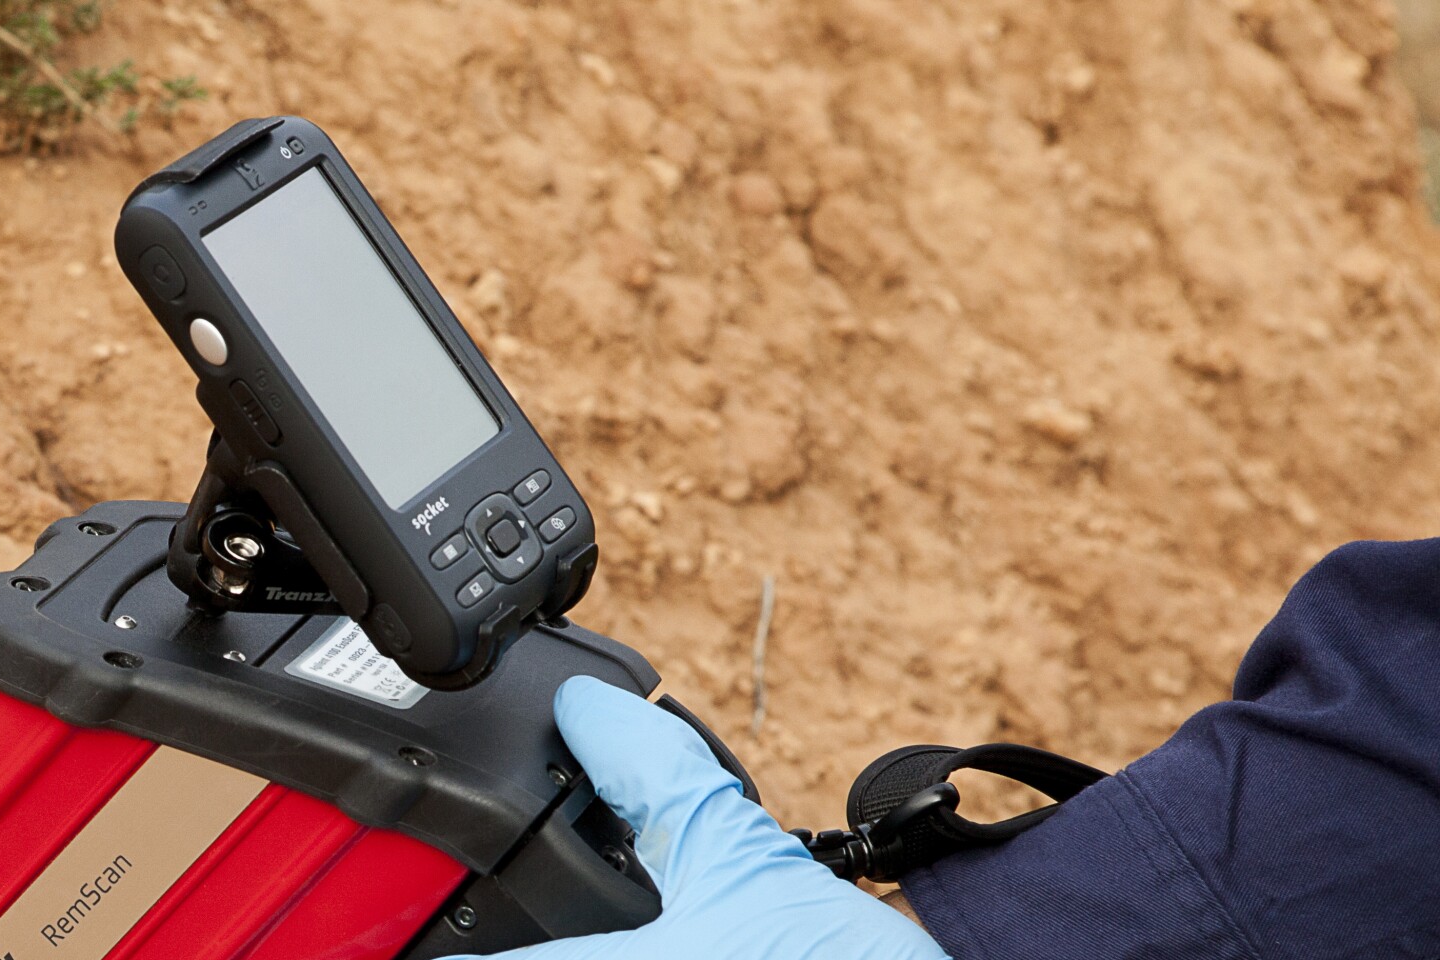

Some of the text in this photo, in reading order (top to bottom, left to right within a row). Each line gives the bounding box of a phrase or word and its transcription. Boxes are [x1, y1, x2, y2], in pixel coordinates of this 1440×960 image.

[411, 496, 449, 536] socket
[327, 667, 345, 678] Part
[343, 670, 364, 684] Serial
[40, 854, 133, 947] RemScan
